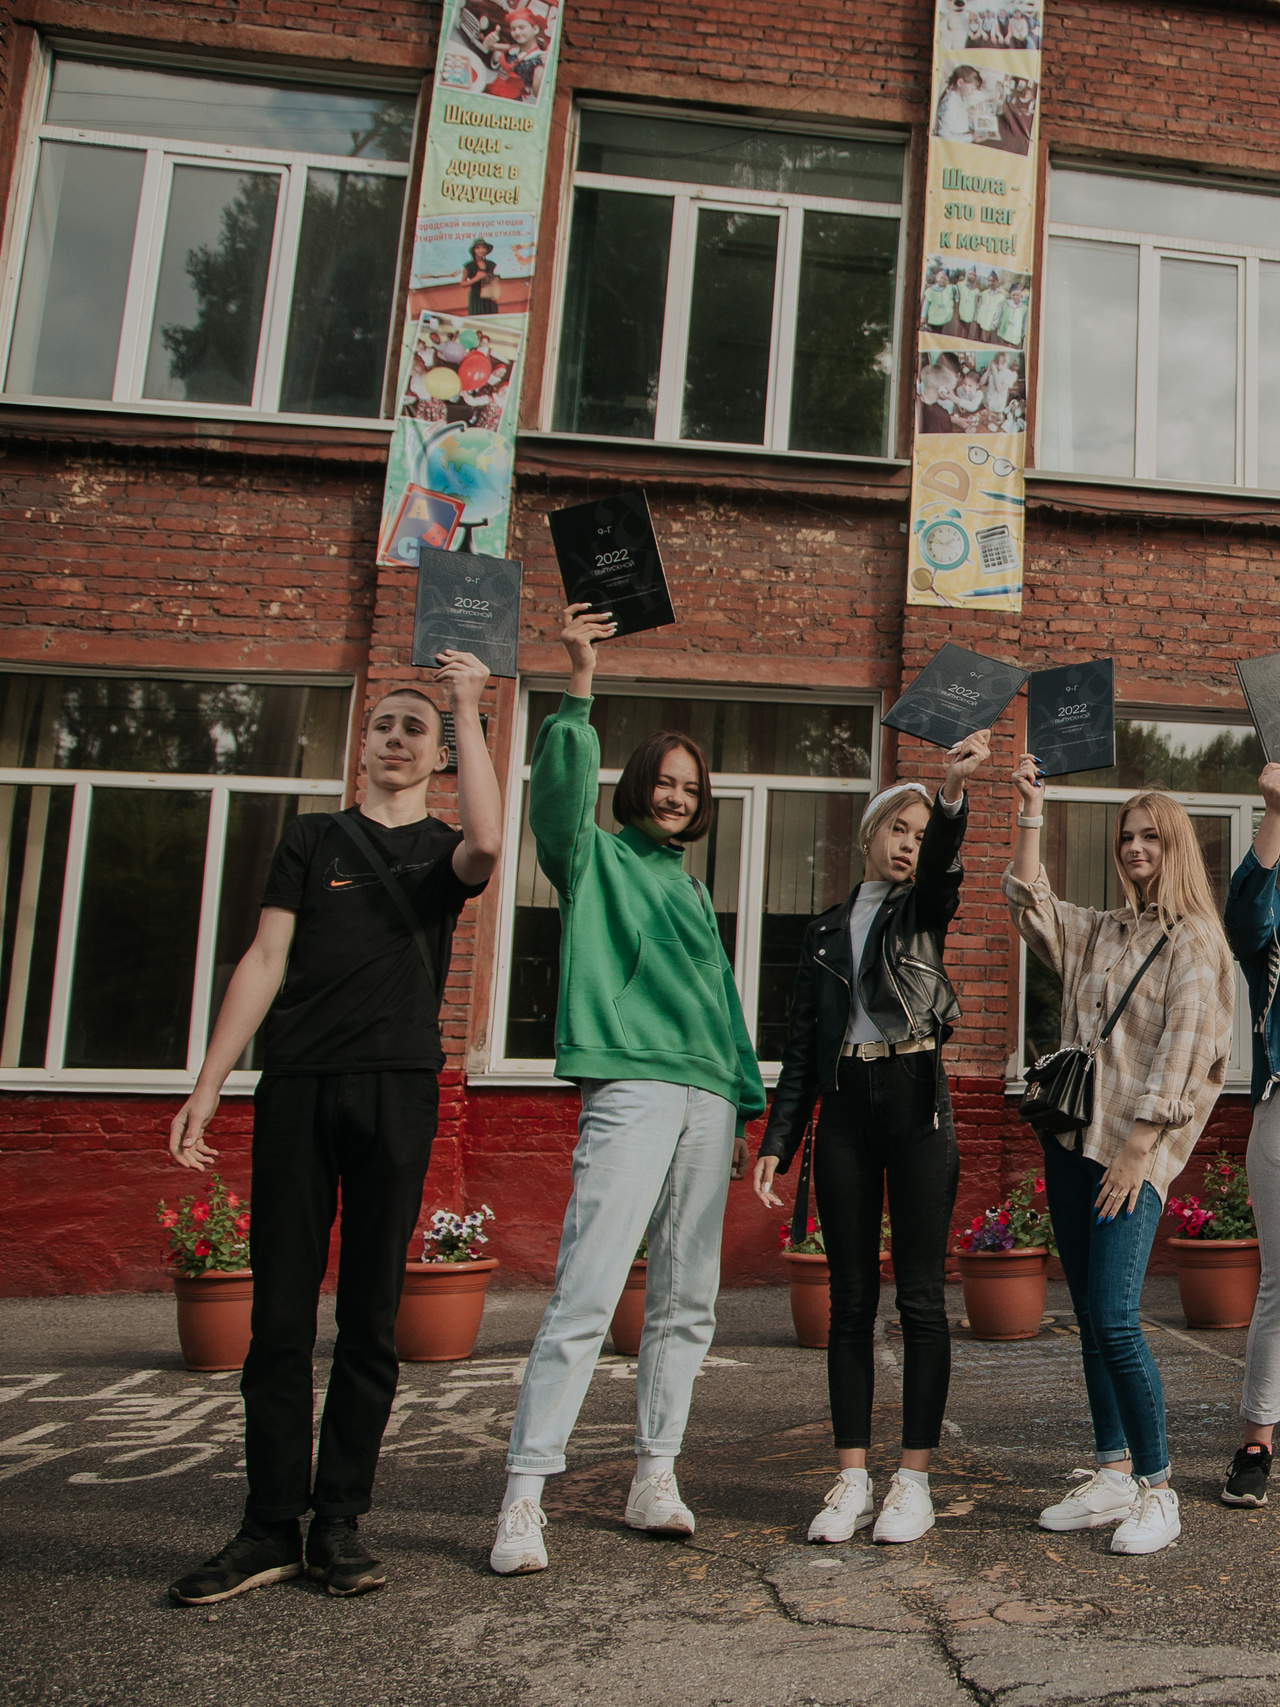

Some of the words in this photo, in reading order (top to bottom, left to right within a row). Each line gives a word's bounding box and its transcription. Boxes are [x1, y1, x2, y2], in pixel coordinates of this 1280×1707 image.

[443, 104, 534, 132] Школьные
[458, 134, 501, 155] годы
[446, 158, 504, 179] дорога
[508, 165, 519, 179] в
[942, 167, 1006, 196] Школа
[441, 178, 520, 205] будущее!
[944, 202, 975, 221] это
[980, 205, 1016, 225] шаг
[417, 219, 459, 231] ородской
[461, 221, 495, 229] конкурс
[496, 219, 523, 227] чтецов
[939, 231, 952, 248] к
[956, 231, 1017, 256] мечте!
[597, 526, 612, 536] 9-Г
[595, 548, 629, 567] 2022
[594, 560, 635, 576] ВЫПУСКНОЙ
[465, 576, 481, 585] 9-Г
[454, 596, 490, 611] 2022
[448, 607, 493, 619] ВЫПУСКНОЙ
[969, 671, 984, 680] 9-Г
[947, 683, 981, 700] 2022
[1065, 684, 1079, 693] 9-Г
[1054, 711, 1091, 725] ВЫПУСКНОЙ
[1057, 703, 1088, 717] 2022
